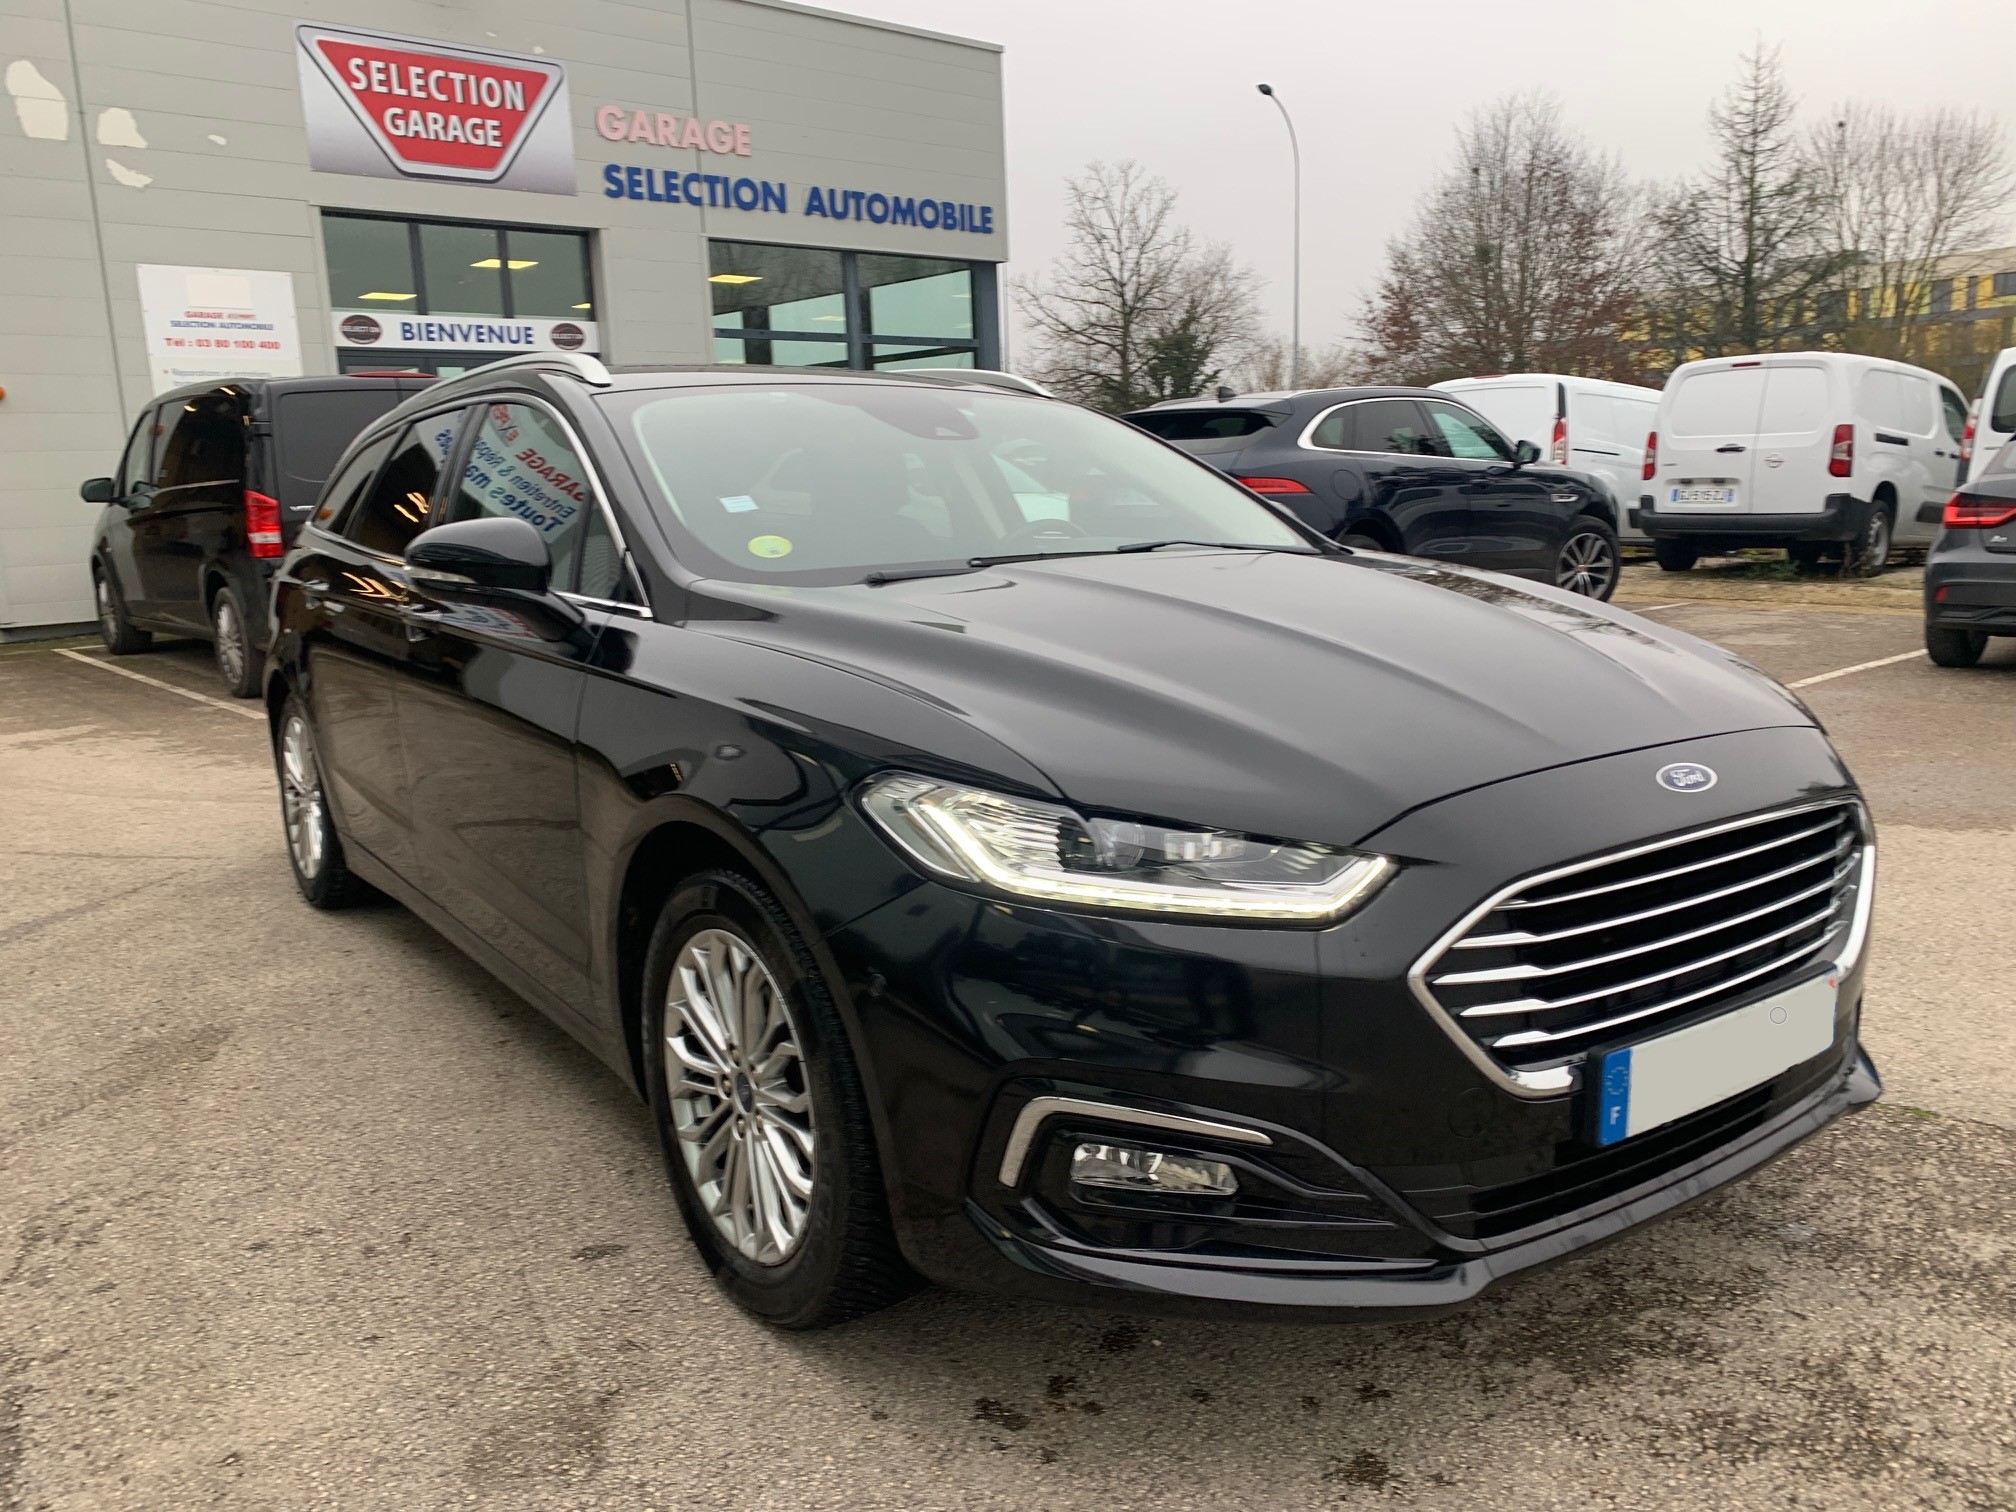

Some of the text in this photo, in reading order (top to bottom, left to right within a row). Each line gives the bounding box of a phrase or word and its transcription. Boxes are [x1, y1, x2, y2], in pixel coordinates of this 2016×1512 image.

[348, 57, 525, 111] SELECTION
[383, 107, 503, 148] GARAGE
[596, 104, 752, 157] GARAGE
[603, 163, 993, 234] SELECTION AUTOMOBILE
[170, 320, 274, 331] SELECTION AUTOMOBILE
[400, 322, 535, 344] BIENVENUE
[1670, 768, 1706, 787] Ford
[1610, 1106, 1621, 1125] F
